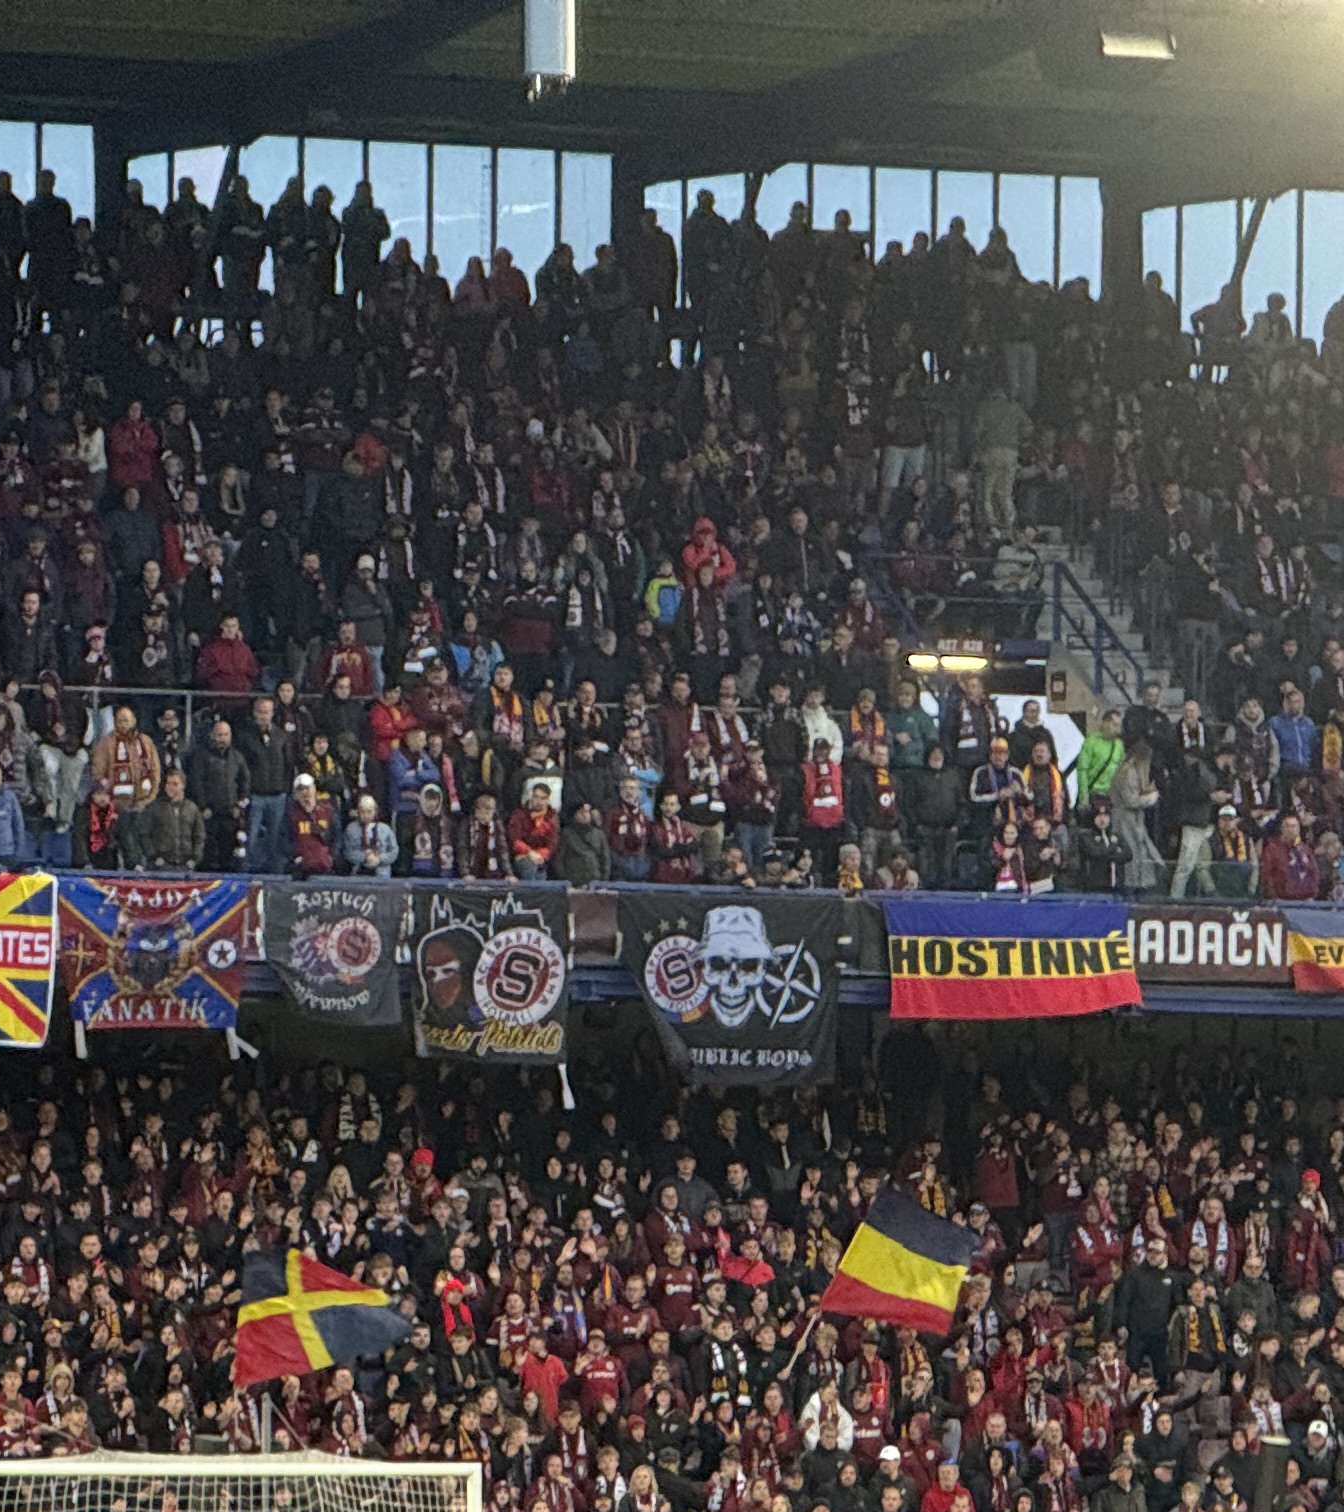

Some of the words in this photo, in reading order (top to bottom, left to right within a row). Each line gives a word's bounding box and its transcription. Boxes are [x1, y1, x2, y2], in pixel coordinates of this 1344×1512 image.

[103, 885, 204, 907] ZAJDA
[890, 931, 1132, 976] HOSTINNÉ
[1128, 911, 1292, 967] ADAČN
[82, 997, 208, 1023] FANATIK
